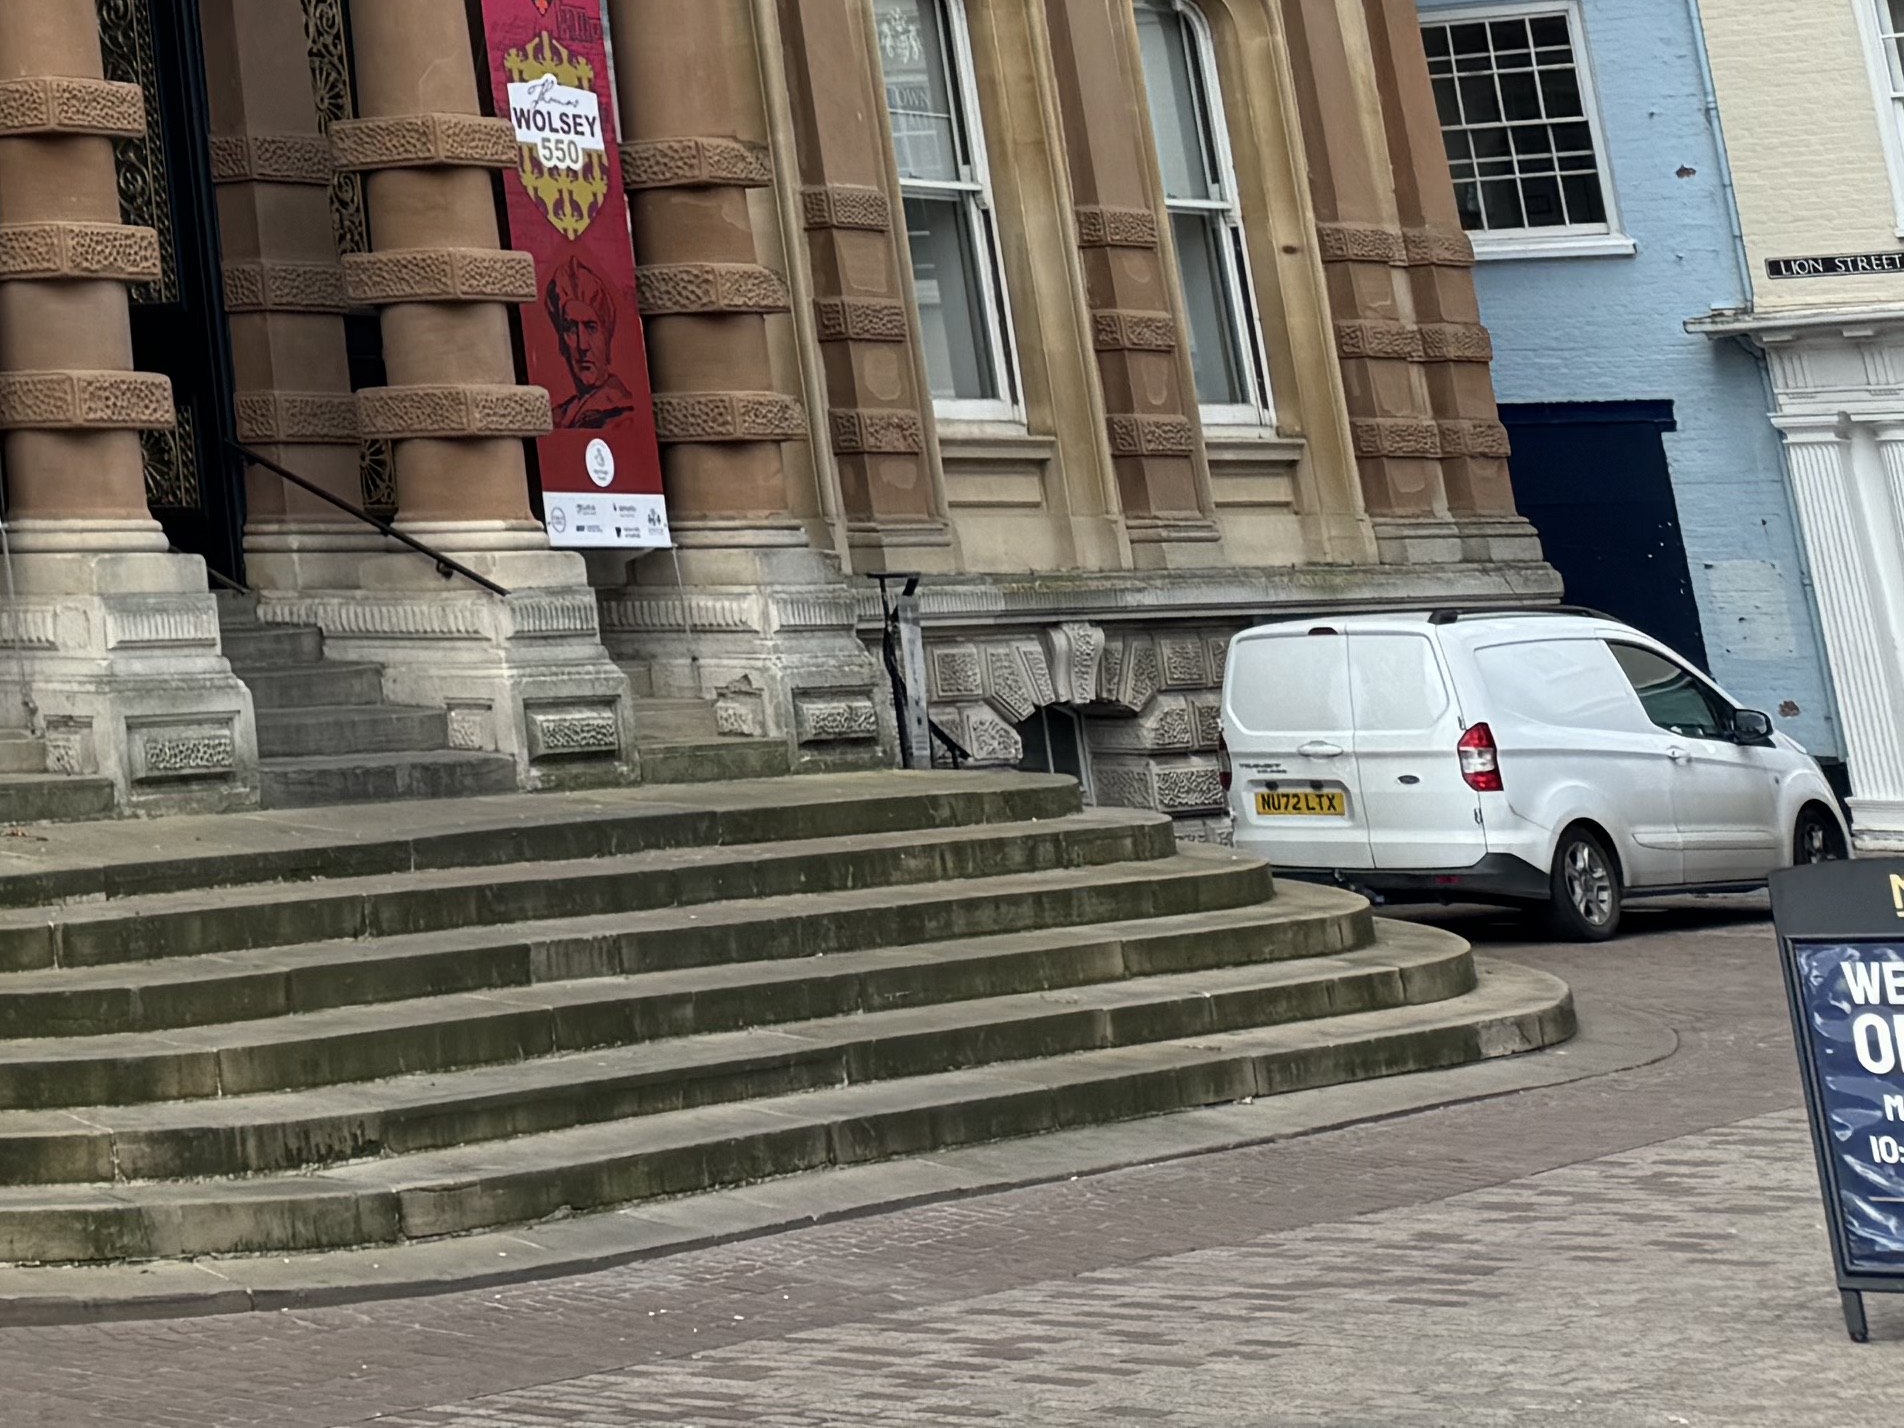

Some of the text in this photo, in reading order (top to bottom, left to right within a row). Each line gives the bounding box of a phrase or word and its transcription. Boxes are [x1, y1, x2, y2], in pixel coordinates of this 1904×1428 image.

[512, 107, 597, 138] WOLSEY
[541, 137, 579, 164] 550
[1779, 254, 1902, 275] LION STREET
[1260, 793, 1337, 812] NU72 LTX
